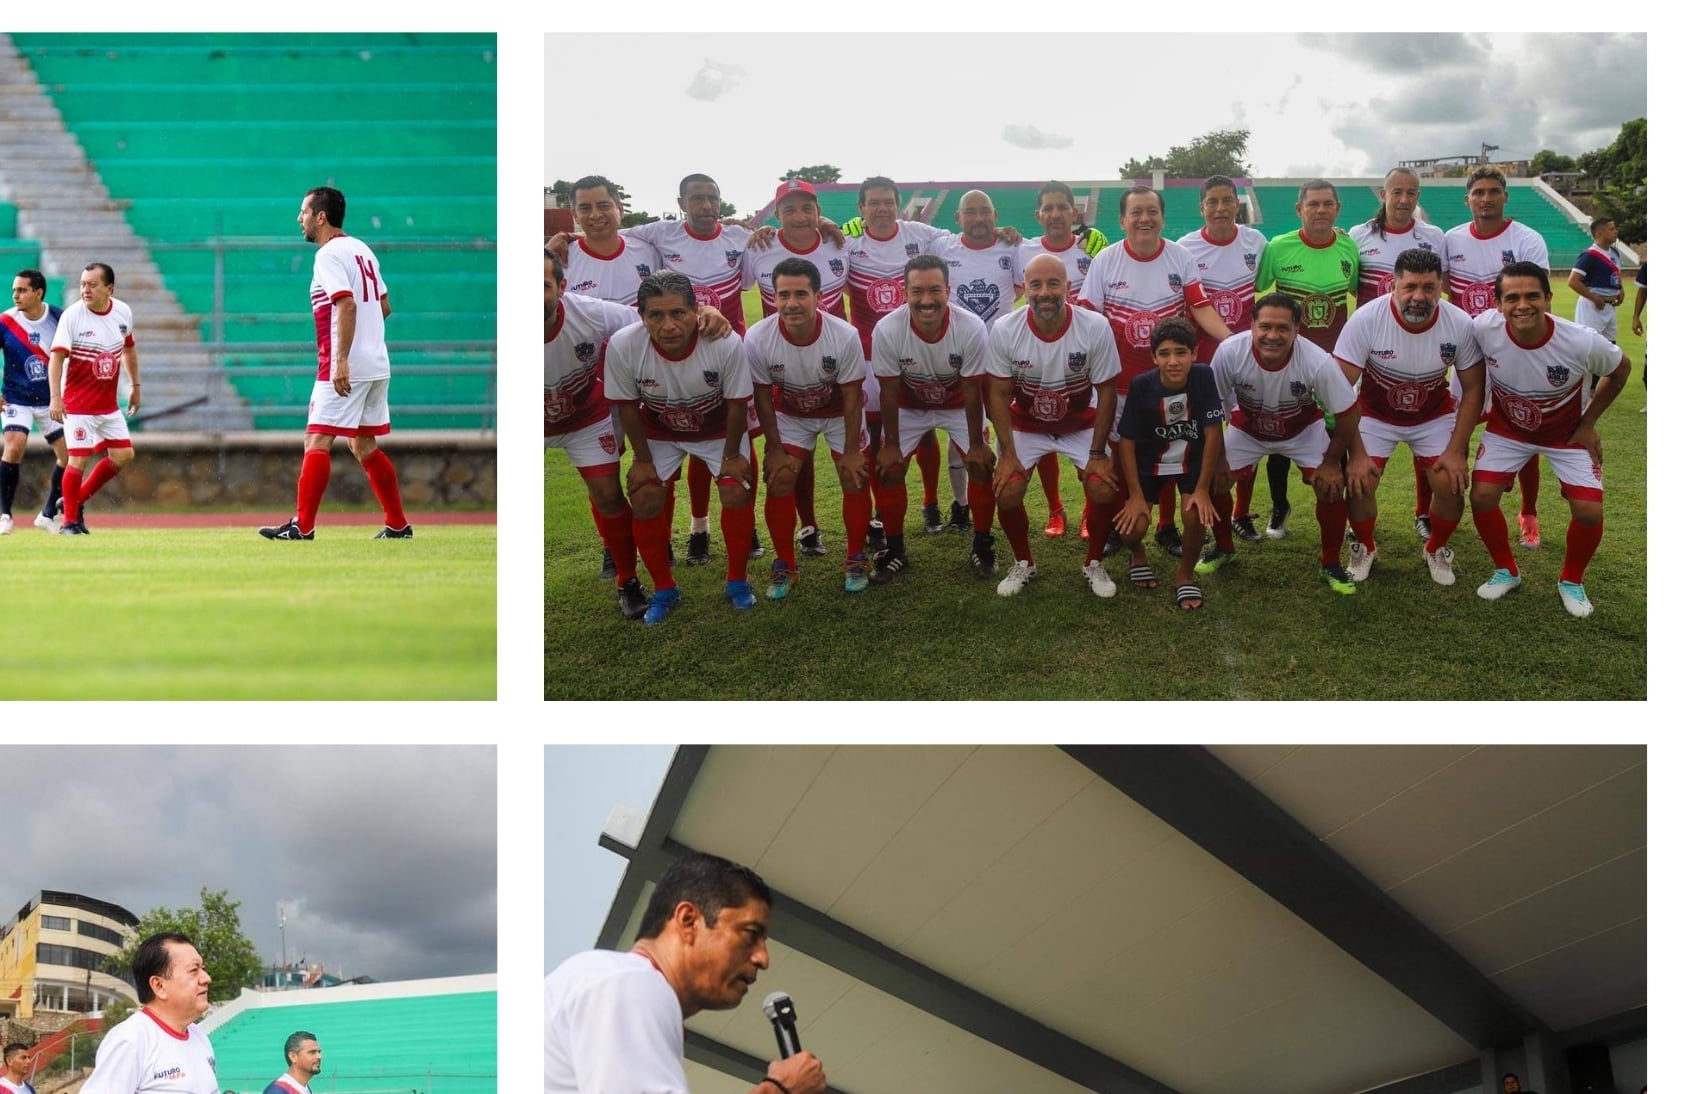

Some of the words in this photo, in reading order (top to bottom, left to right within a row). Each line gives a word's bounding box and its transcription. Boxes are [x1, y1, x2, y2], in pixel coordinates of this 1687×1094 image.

[355, 255, 380, 302] 14
[1154, 419, 1198, 439] QATAR
[153, 1067, 180, 1080] FUTURO
